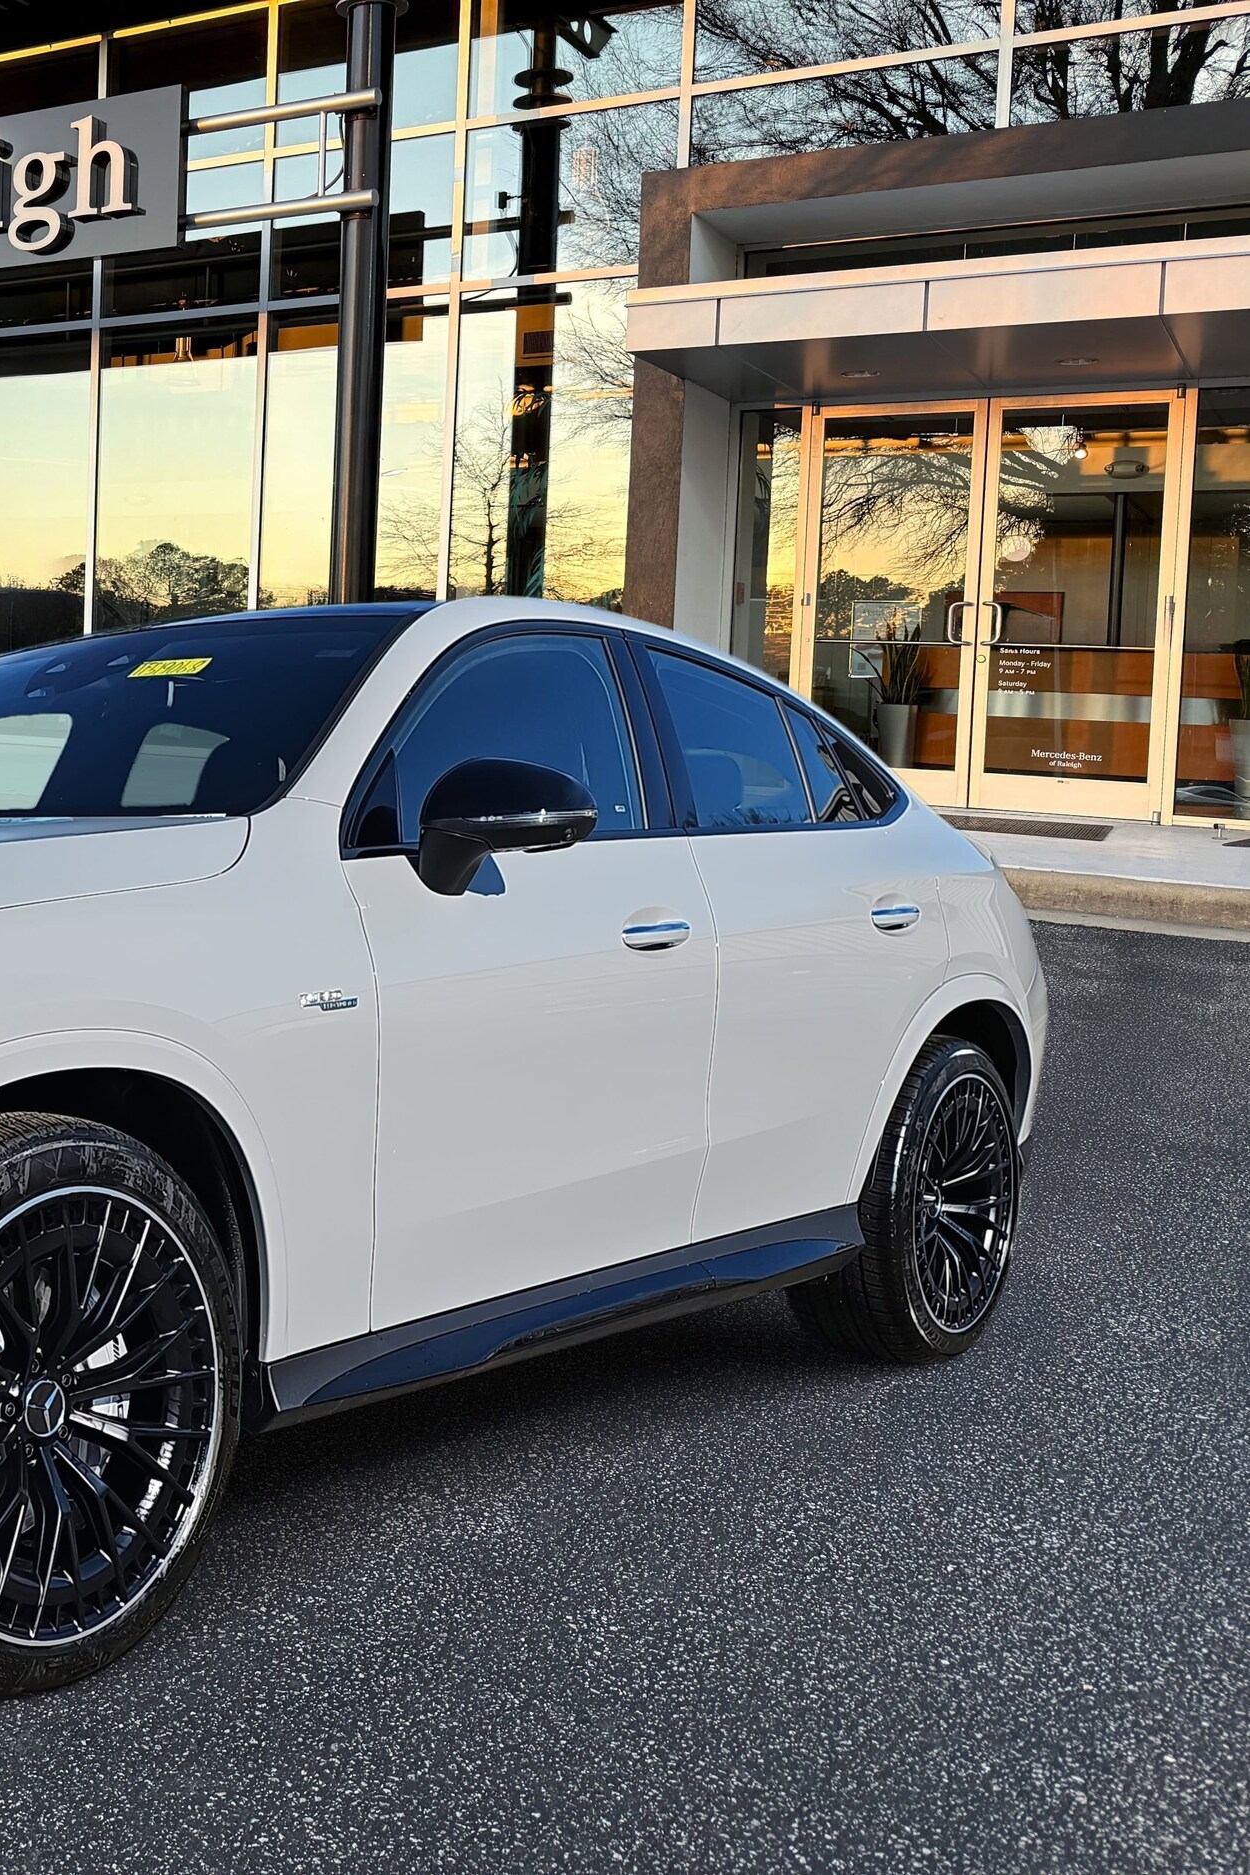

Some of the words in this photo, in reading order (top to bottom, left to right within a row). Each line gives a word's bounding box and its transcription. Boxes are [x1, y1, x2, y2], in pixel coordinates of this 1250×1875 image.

[998, 680, 1027, 688] Saturday
[1031, 749, 1103, 761] Mercedes-Benz
[1057, 761, 1082, 769] Raleigh
